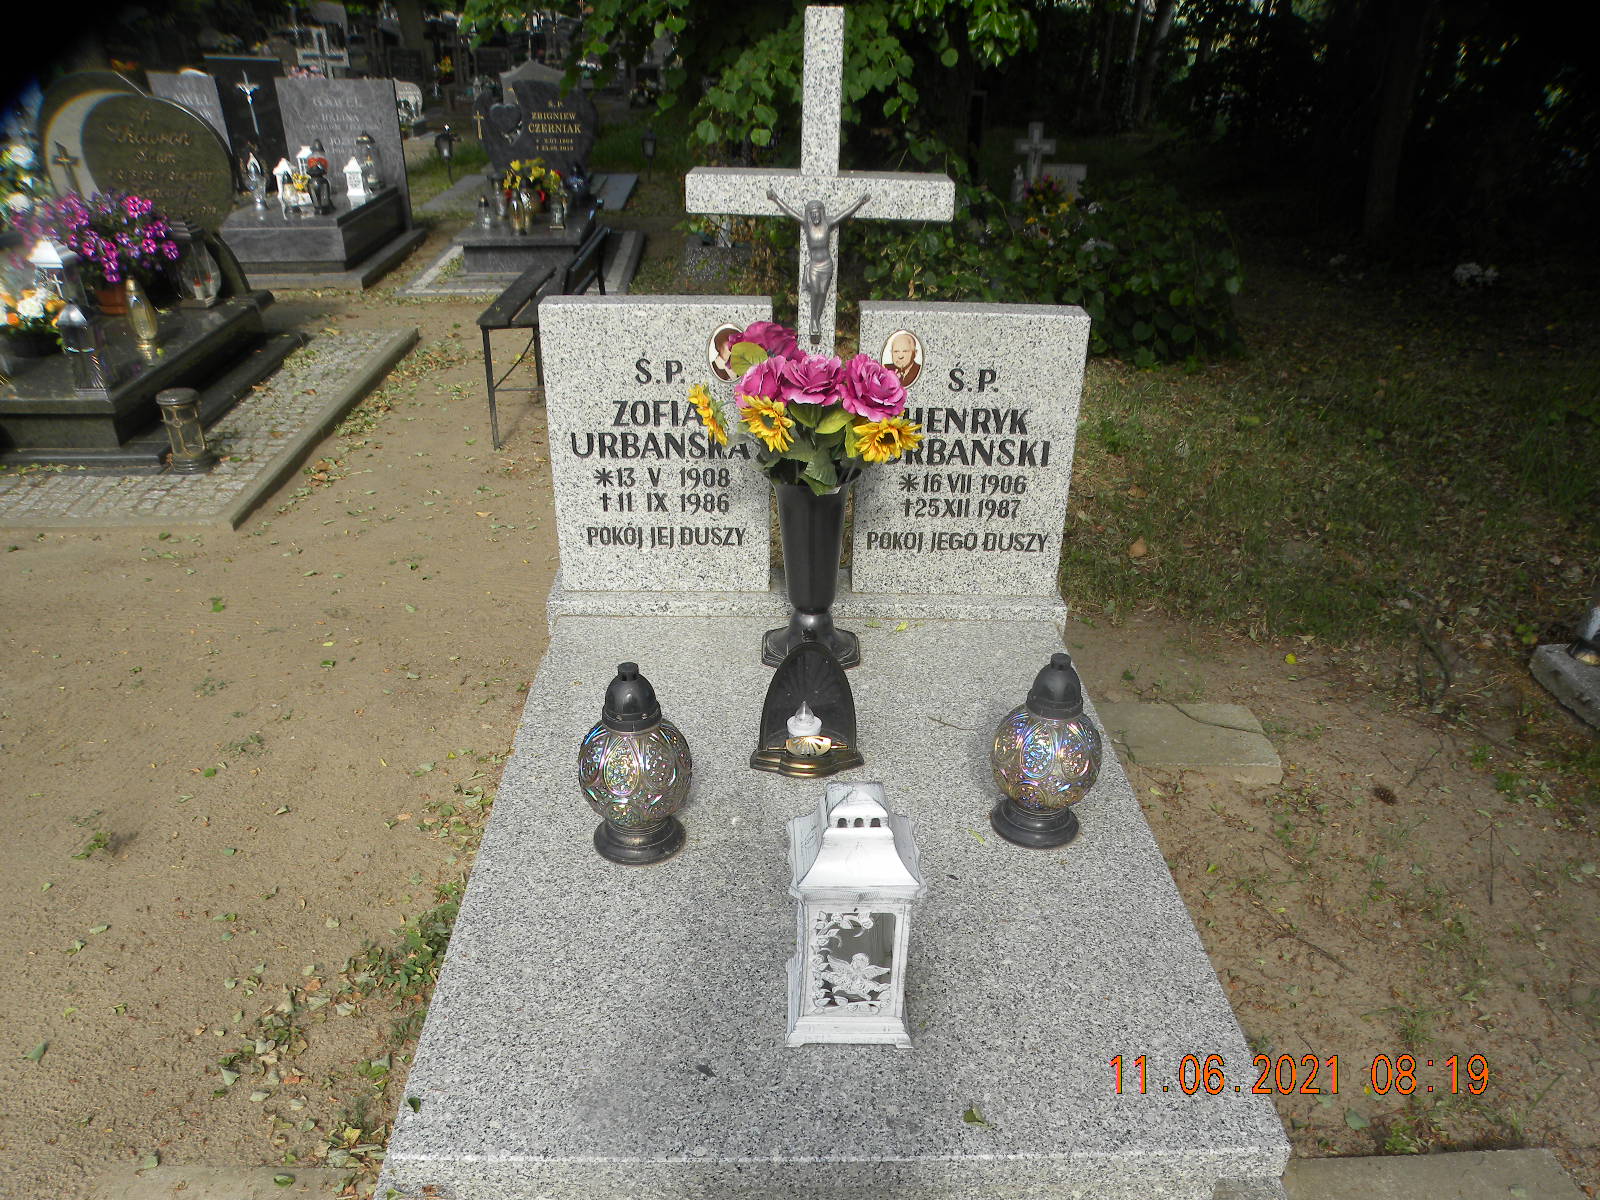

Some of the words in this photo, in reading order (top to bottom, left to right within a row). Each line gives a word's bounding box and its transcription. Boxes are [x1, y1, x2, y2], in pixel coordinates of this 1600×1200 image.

[531, 112, 577, 120] ZBIGNIEW
[528, 123, 582, 134] CZERNIAK
[612, 400, 708, 427] ZOFIA
[886, 436, 1050, 467] RBAŃSKI
[647, 467, 661, 487] V
[680, 467, 731, 490] 1908
[947, 474, 972, 494] VII
[981, 475, 1028, 496] 1906
[647, 492, 669, 512] IX
[680, 492, 730, 515] 1986
[977, 499, 1021, 521] 1987
[650, 526, 675, 549] JEJ
[681, 526, 746, 546] DUSZY
[930, 532, 978, 553] JEGO
[983, 532, 1049, 552] DUSZY
